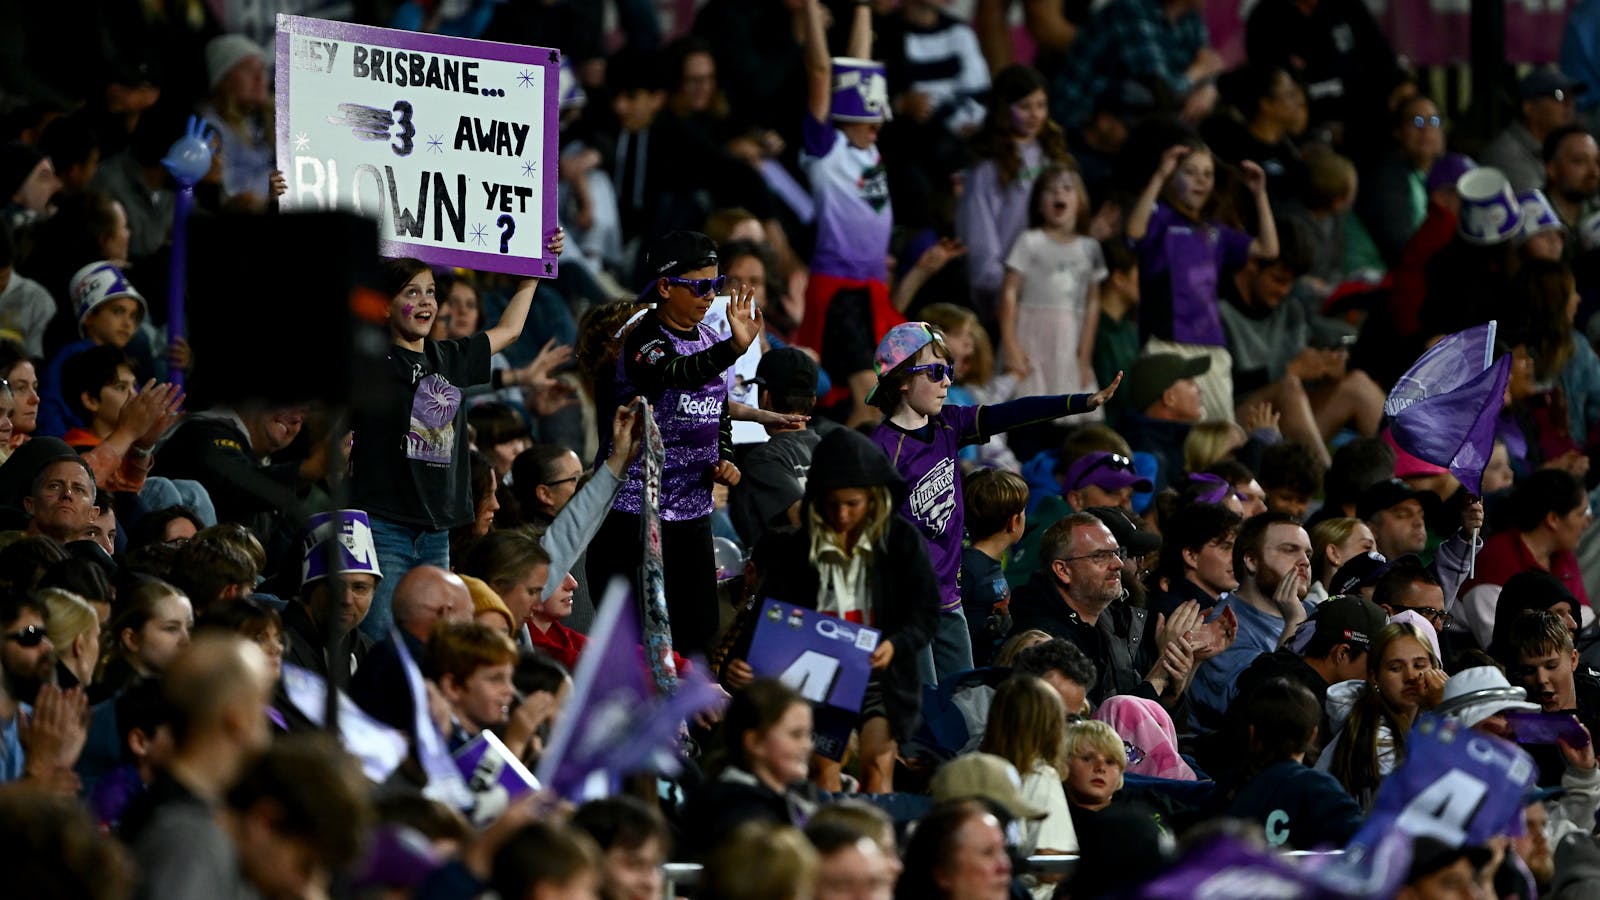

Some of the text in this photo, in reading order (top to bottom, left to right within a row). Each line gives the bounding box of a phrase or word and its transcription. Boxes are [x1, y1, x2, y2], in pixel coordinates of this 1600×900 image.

[453, 116, 530, 157] AWAY
[482, 181, 533, 213] YET
[496, 214, 516, 254] ?
[1265, 808, 1291, 847] C
